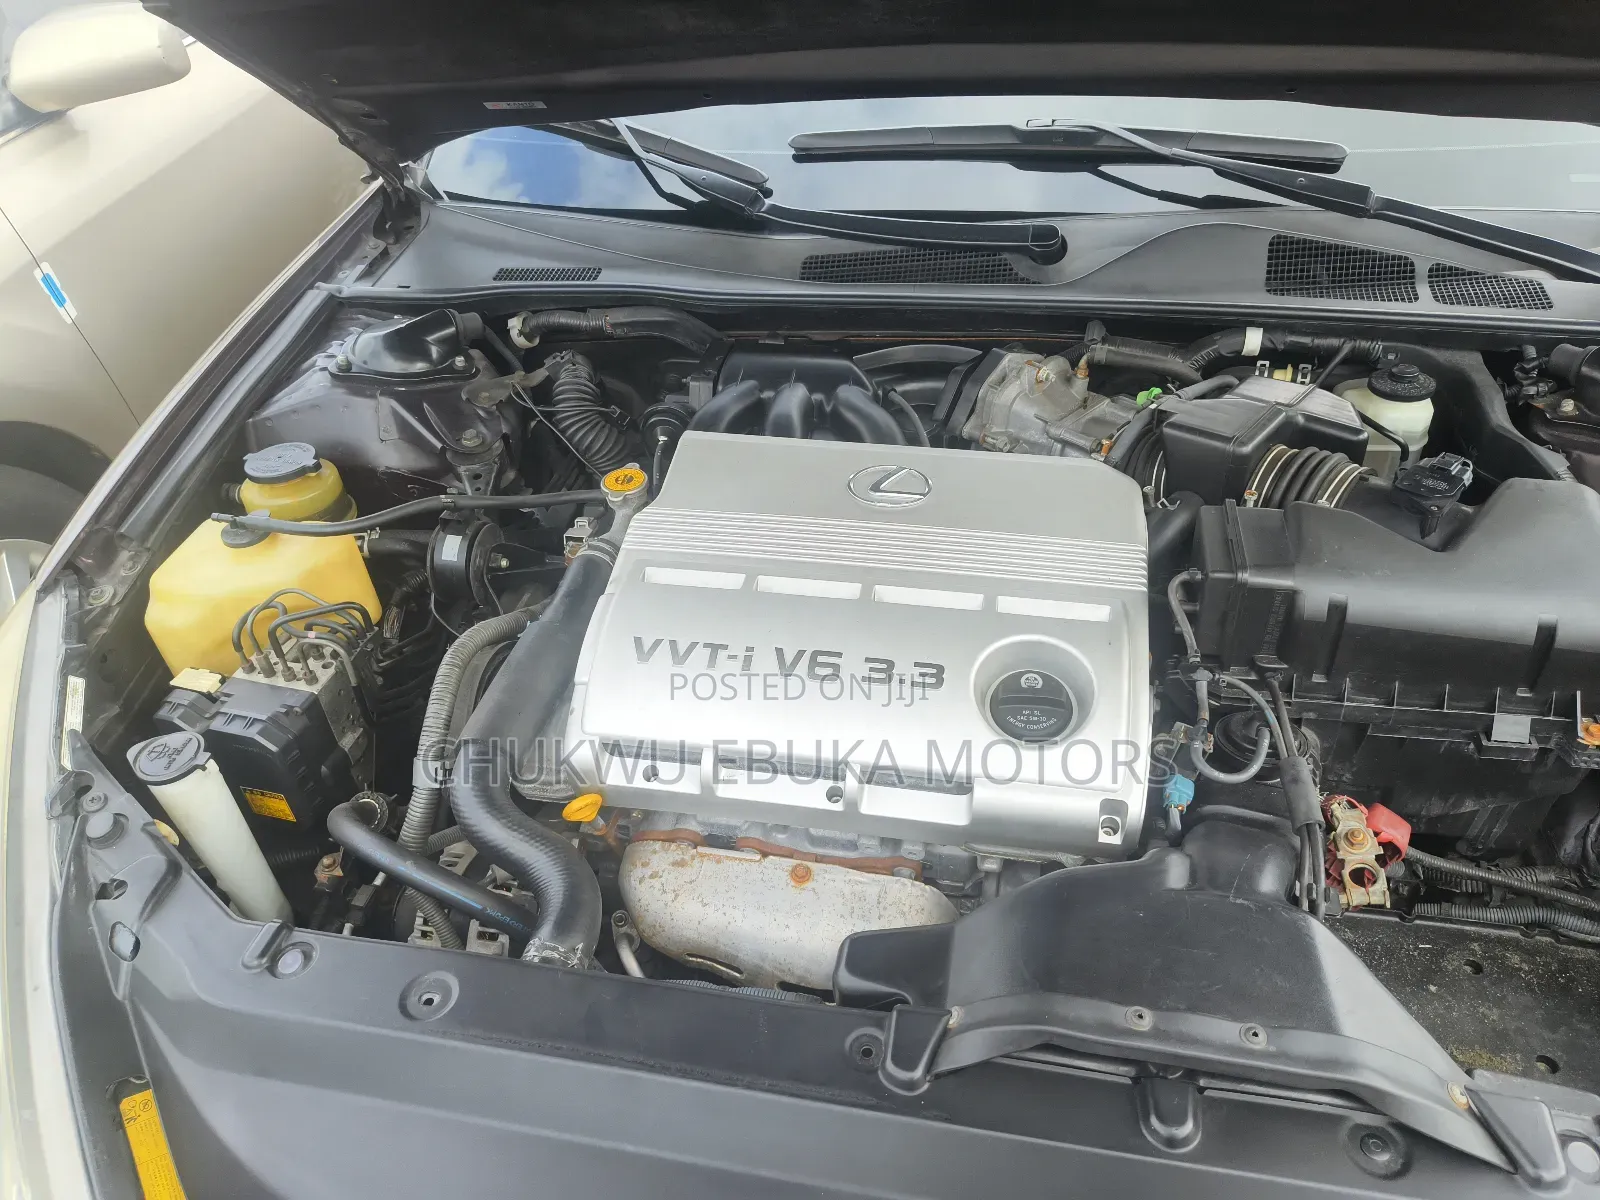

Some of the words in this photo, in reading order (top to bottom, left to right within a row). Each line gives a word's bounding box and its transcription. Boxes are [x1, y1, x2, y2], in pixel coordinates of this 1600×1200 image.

[633, 636, 755, 672] VVT-i
[774, 646, 843, 682] V6
[861, 656, 946, 690] 3.3
